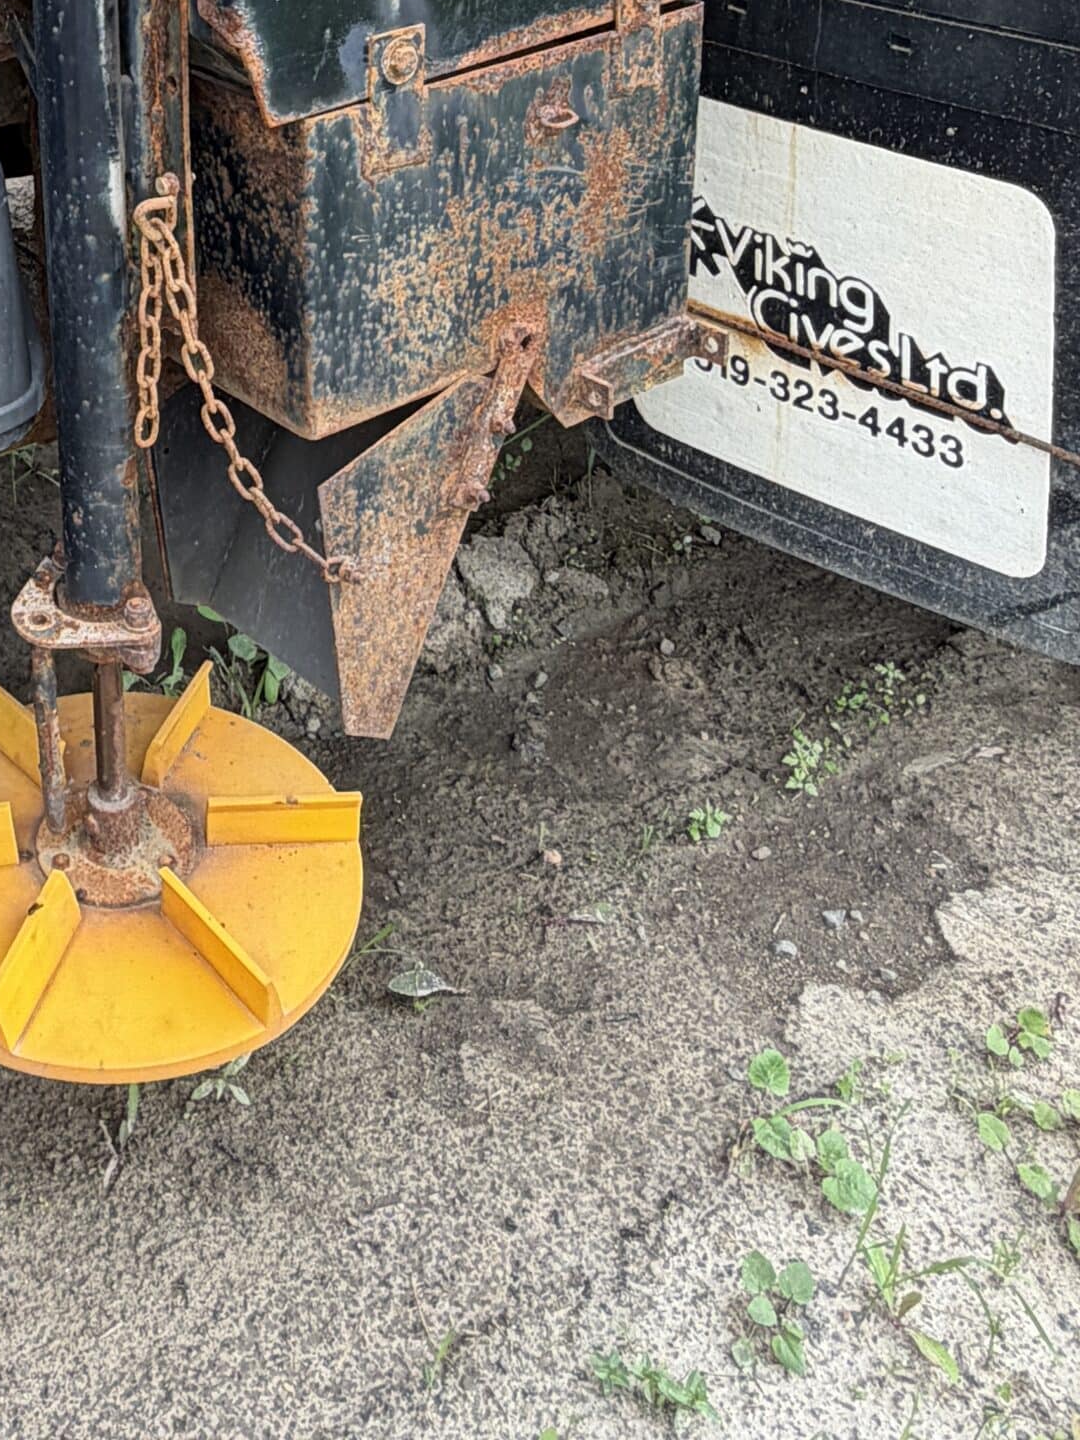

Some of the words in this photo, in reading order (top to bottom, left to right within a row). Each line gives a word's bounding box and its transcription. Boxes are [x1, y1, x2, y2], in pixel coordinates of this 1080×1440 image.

[715, 218, 875, 335] Viking
[749, 287, 891, 379] Cives
[901, 333, 1004, 420] Ltd.
